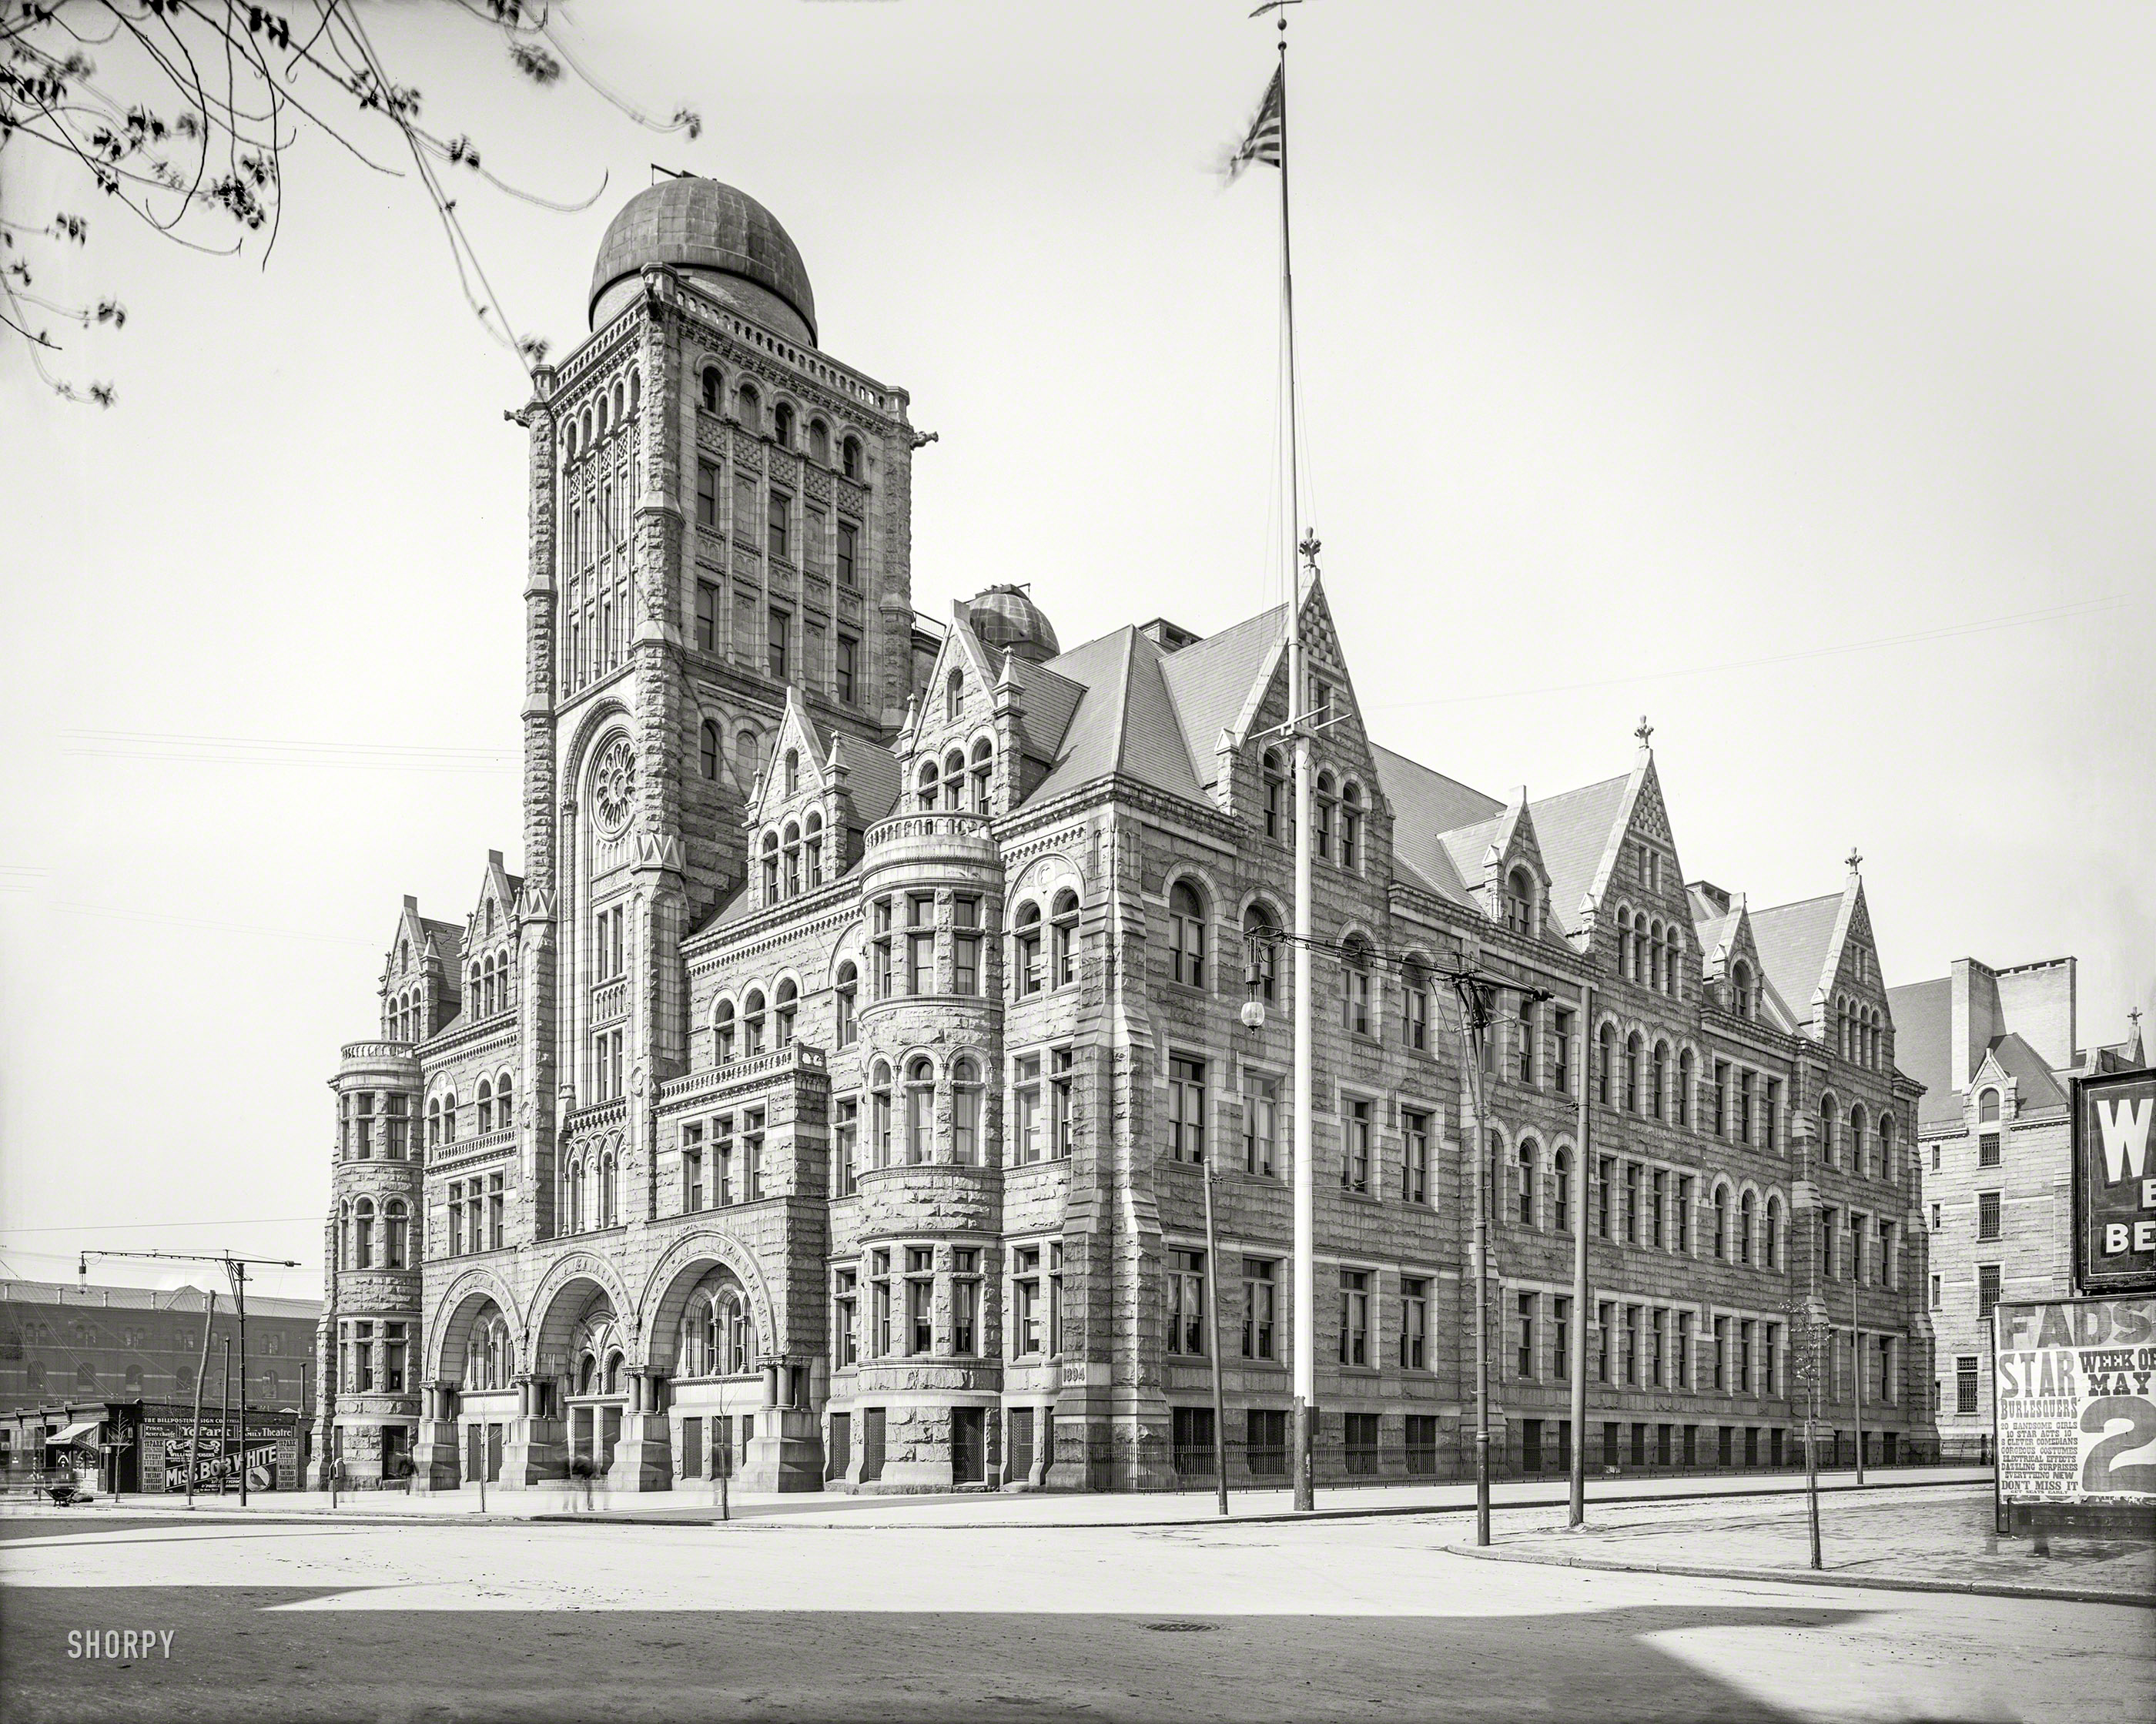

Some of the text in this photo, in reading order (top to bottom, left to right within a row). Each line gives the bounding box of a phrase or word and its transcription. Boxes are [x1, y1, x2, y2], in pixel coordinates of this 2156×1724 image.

[2096, 1098, 2154, 1183] W
[2106, 1220, 2156, 1254] BE
[1999, 1301, 2151, 1349] FADS
[1063, 1367, 1085, 1381] 1894
[1999, 1351, 2076, 1398] STAR
[2079, 1349, 2135, 1373] WEEK
[2088, 1371, 2151, 1397] MAY
[2000, 1397, 2077, 1420] BURLESQUERS
[262, 1427, 292, 1437] Theatre
[2080, 1396, 2156, 1493] 2
[200, 1457, 232, 1479] BOB
[233, 1445, 276, 1471] WHITE
[2001, 1481, 2078, 1491] DON'T MISS IT
